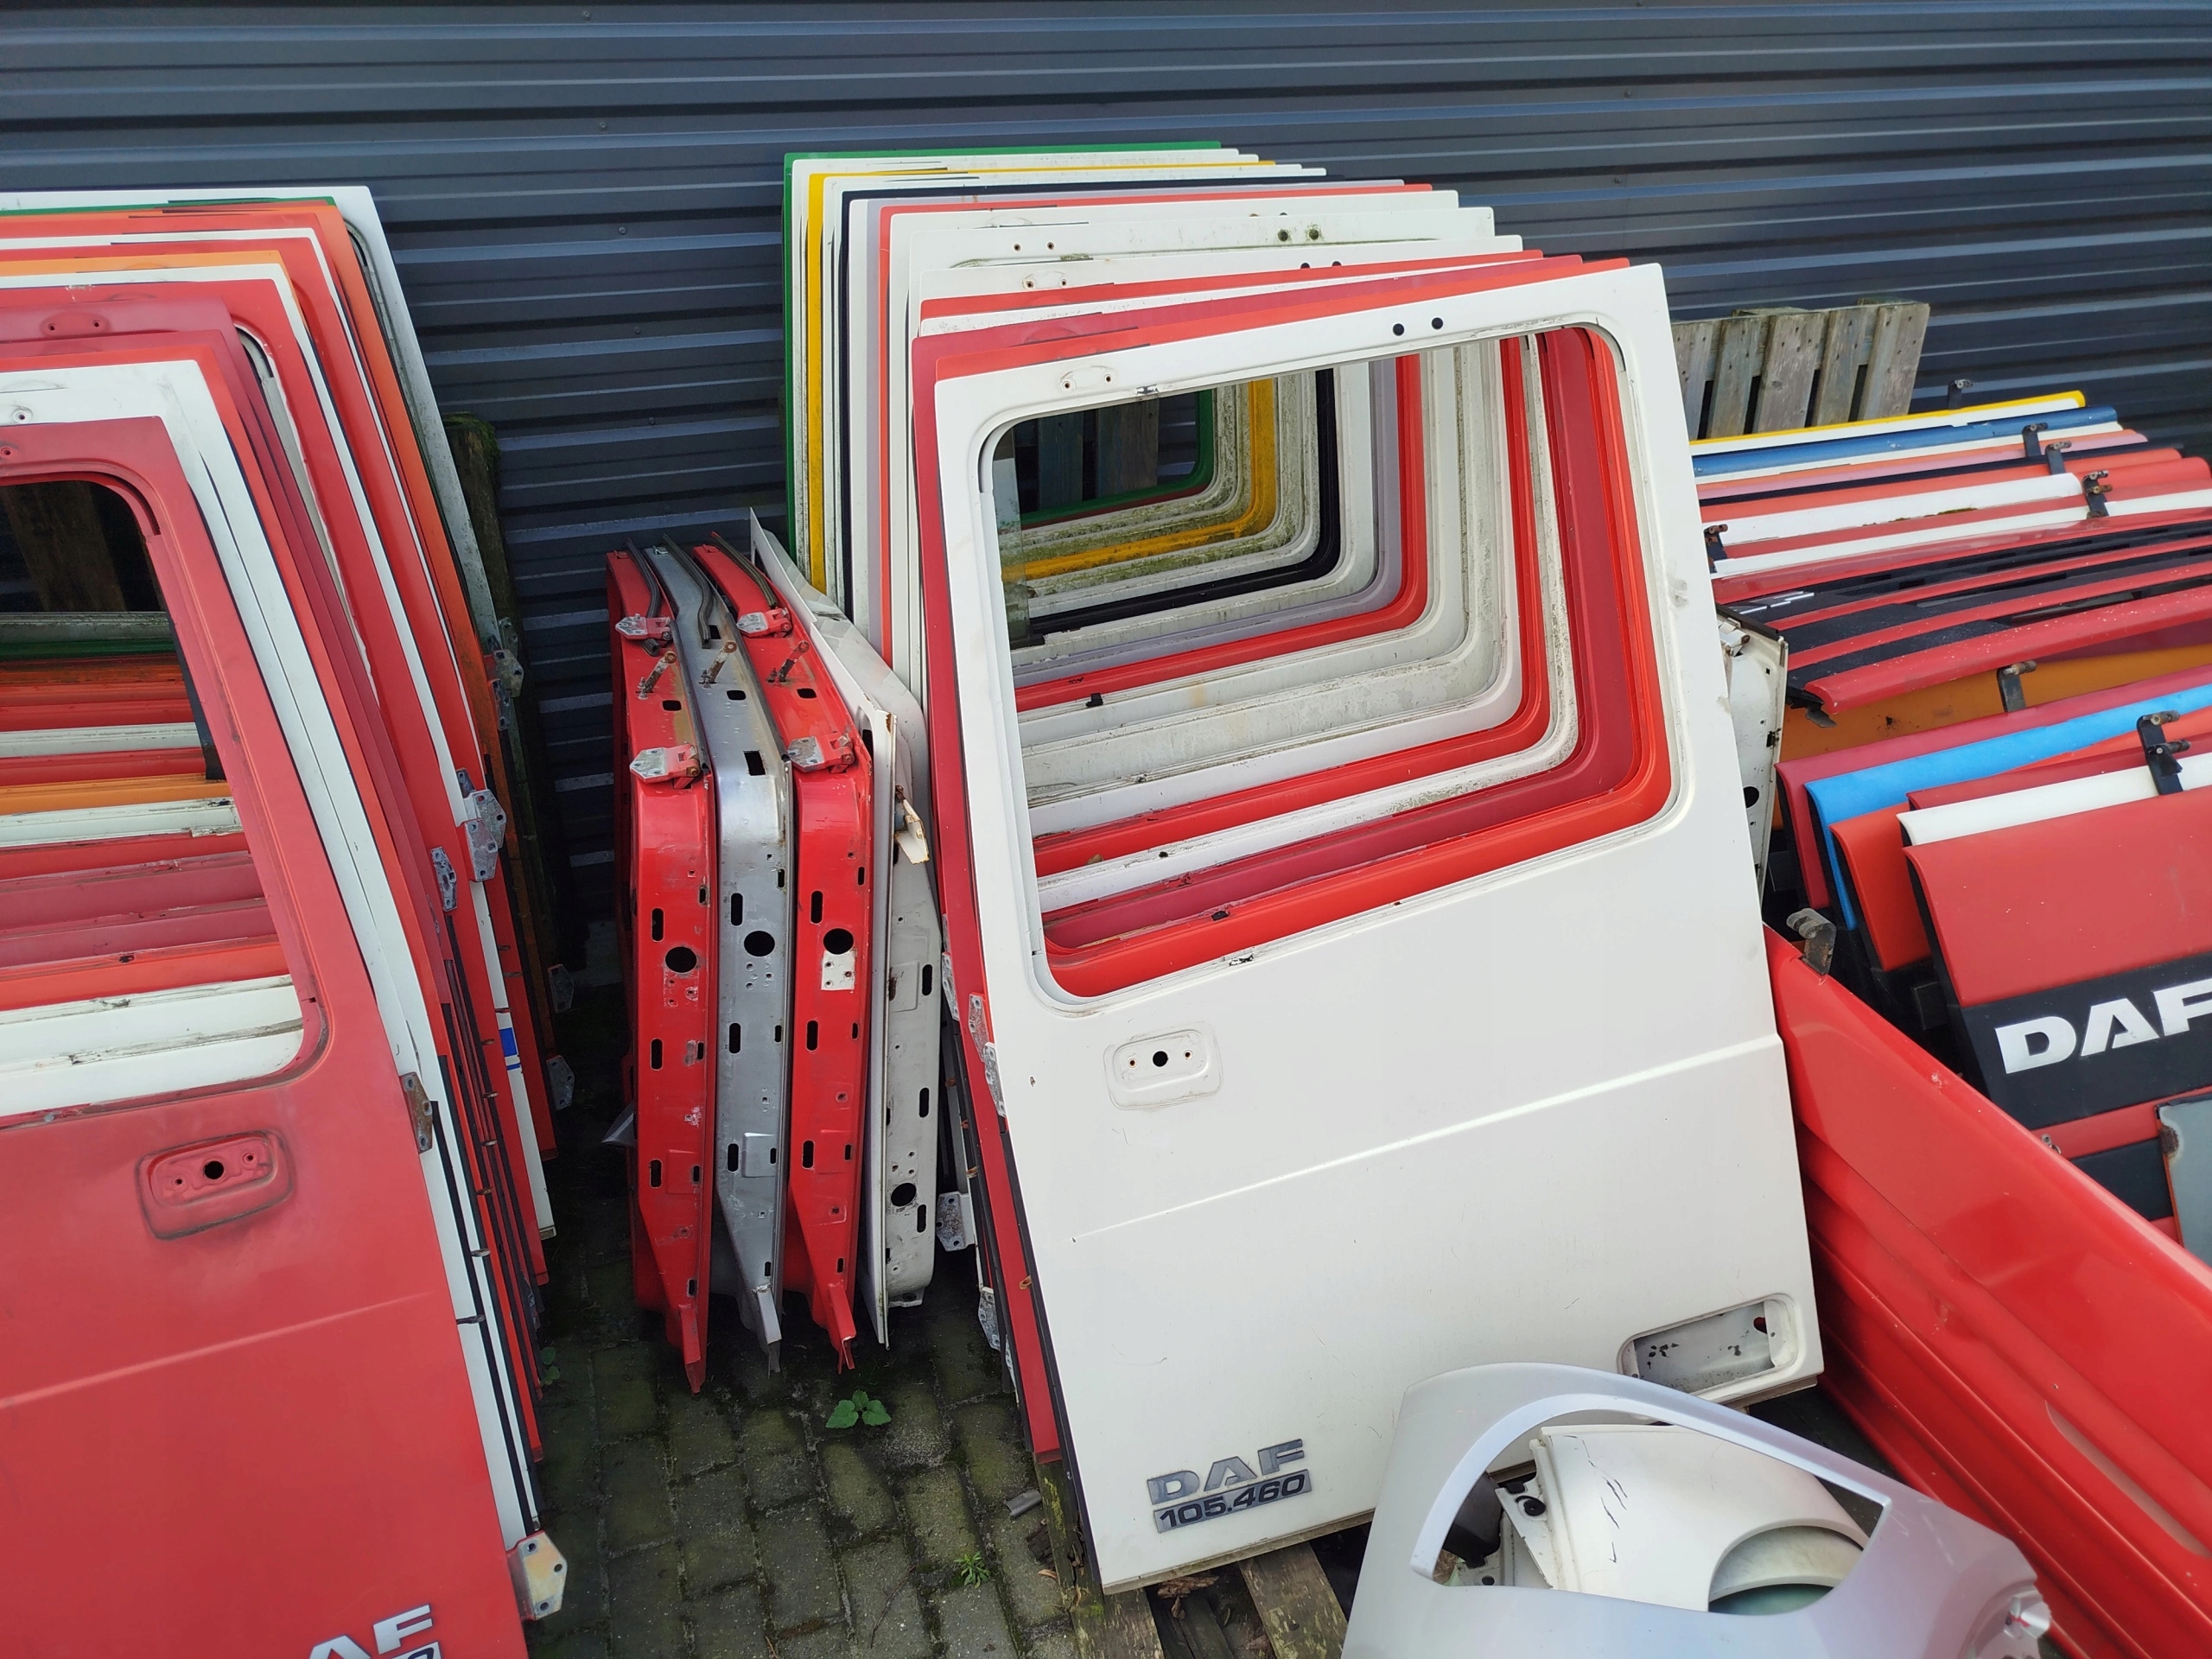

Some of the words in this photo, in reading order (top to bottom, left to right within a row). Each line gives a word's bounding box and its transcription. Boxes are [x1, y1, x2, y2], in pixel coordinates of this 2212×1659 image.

[1994, 977, 2212, 1075] DAF
[1147, 1438, 1305, 1505] DAF
[1159, 1473, 1306, 1528] 105.460
